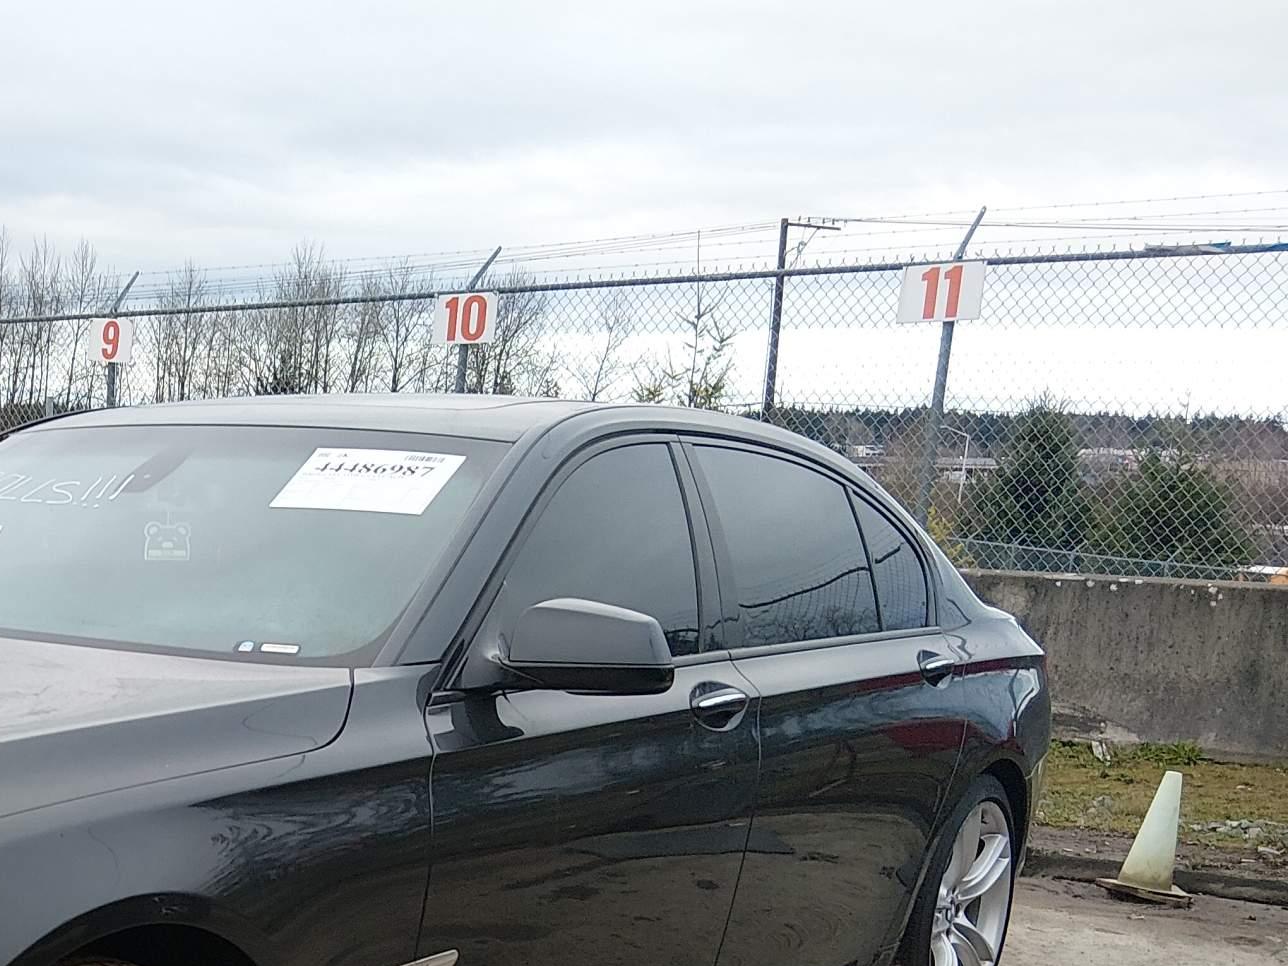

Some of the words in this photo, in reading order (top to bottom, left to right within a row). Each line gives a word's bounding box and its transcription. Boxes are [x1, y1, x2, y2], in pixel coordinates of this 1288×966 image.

[921, 265, 964, 320] 11
[101, 320, 120, 360] 9
[445, 294, 488, 342] 10
[315, 462, 437, 479] 44486987
